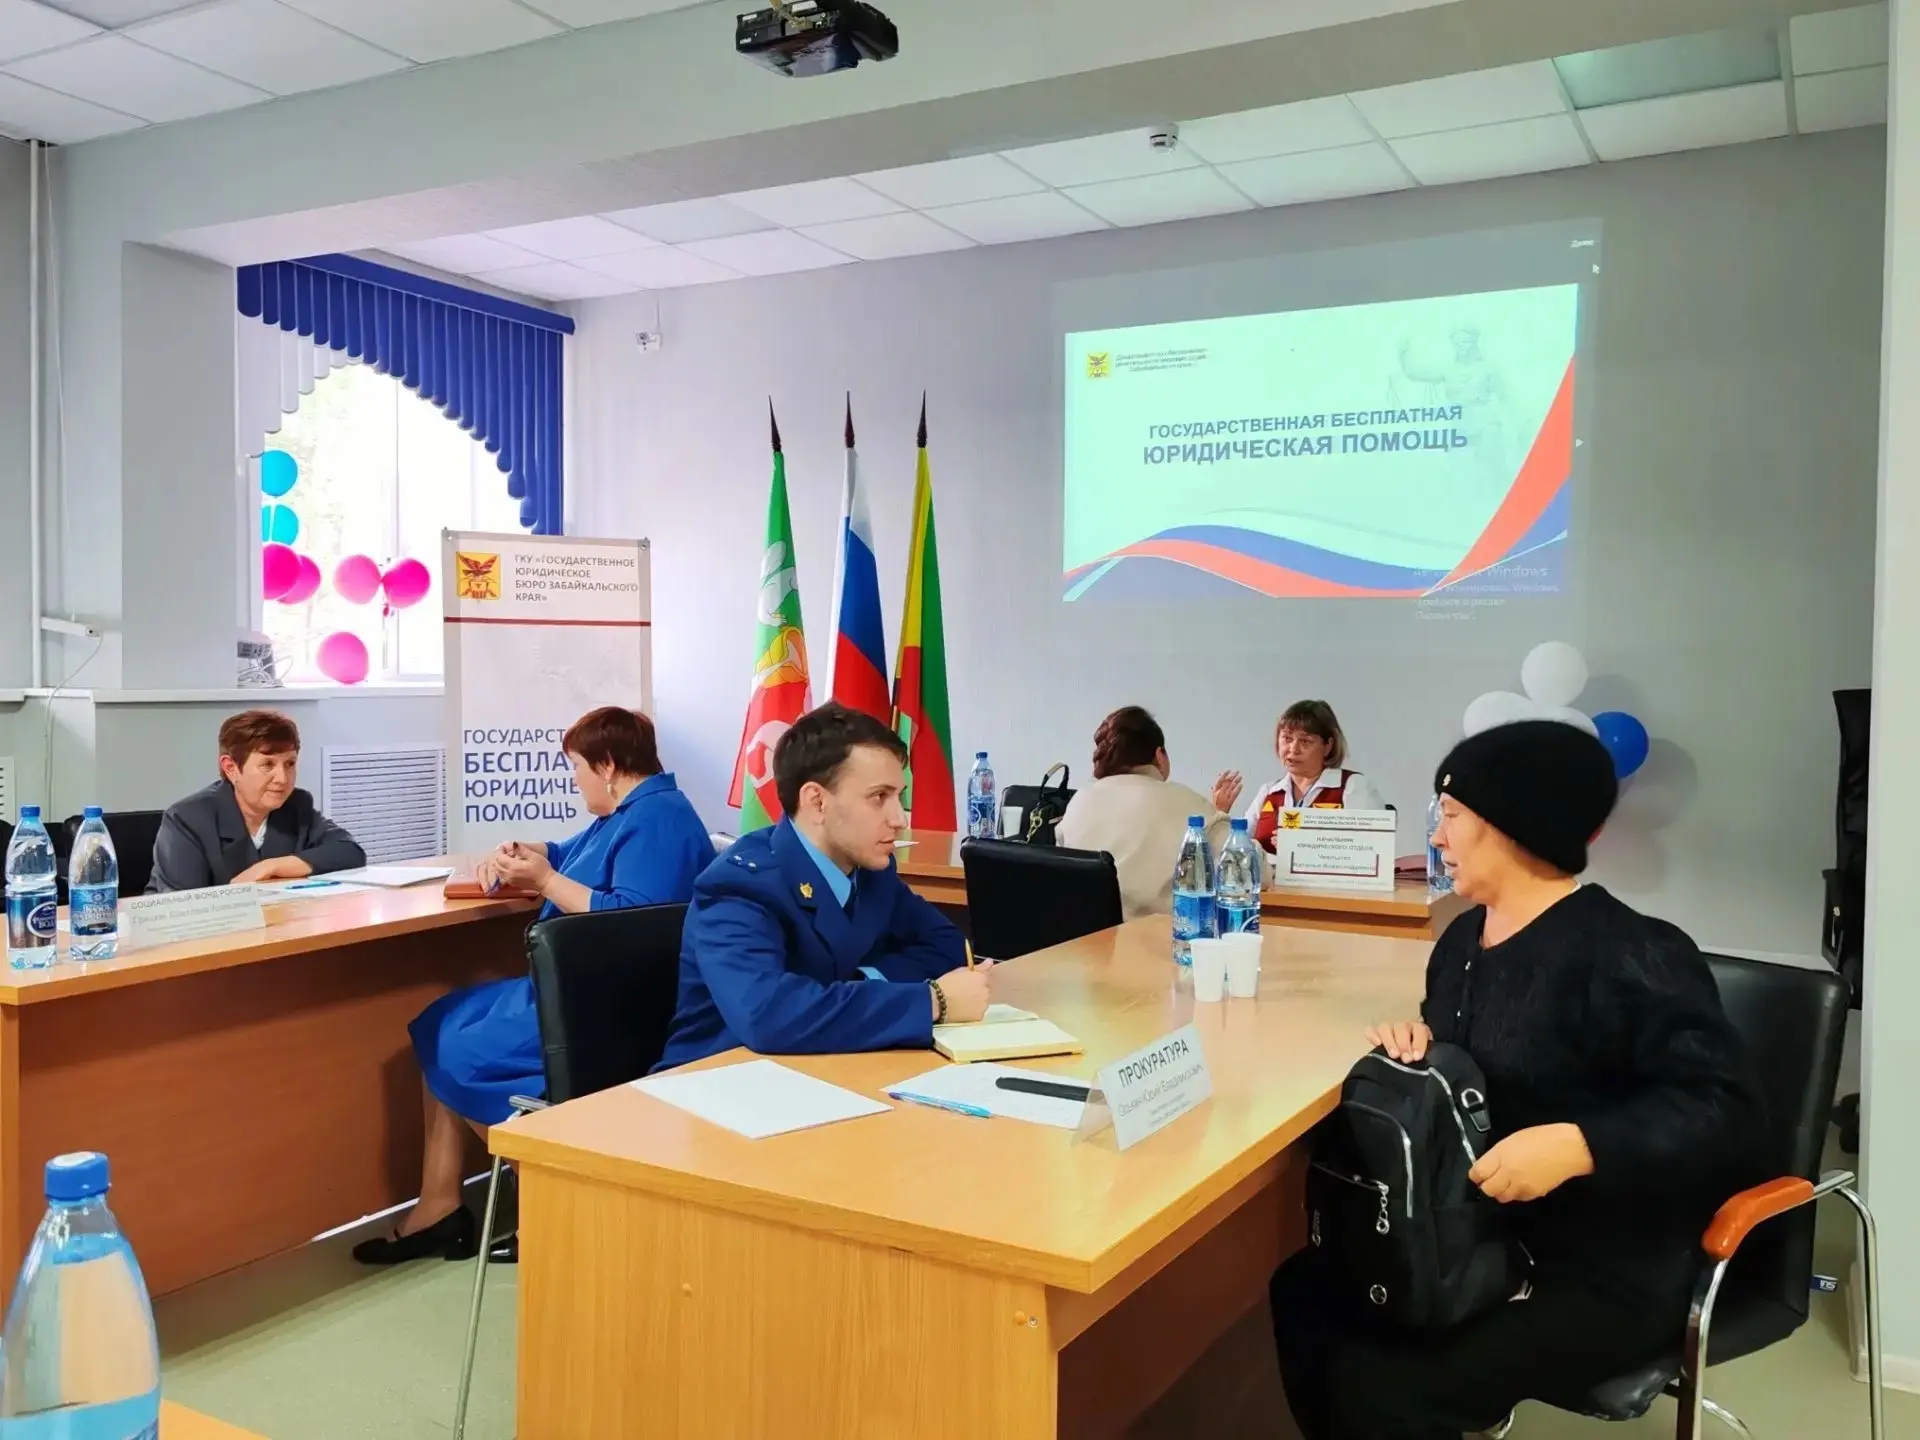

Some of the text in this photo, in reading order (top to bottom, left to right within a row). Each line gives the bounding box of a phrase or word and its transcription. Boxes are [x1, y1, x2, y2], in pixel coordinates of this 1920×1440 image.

[1149, 405, 1463, 440] ГОСУДАРСТВЕННАЯ БЕСПЛАТНАЯ
[1143, 428, 1468, 466] ЮРИДИЧЕСКАЯ ПОМОЩЬ
[514, 554, 636, 568] ГКУ «ГОСУДАРСТВЕННОЕ
[515, 567, 591, 578] ЮРИДИЧЕСКОЕ
[515, 580, 639, 592] БЮРО ЗАБАЙКАЛЬСКОГО
[515, 592, 547, 602] КРАЯ»
[464, 751, 577, 774] БЕСПЛА
[465, 801, 577, 823] ПОМОЩЬ
[1118, 1038, 1190, 1088] ПРОКУРАТУРА
